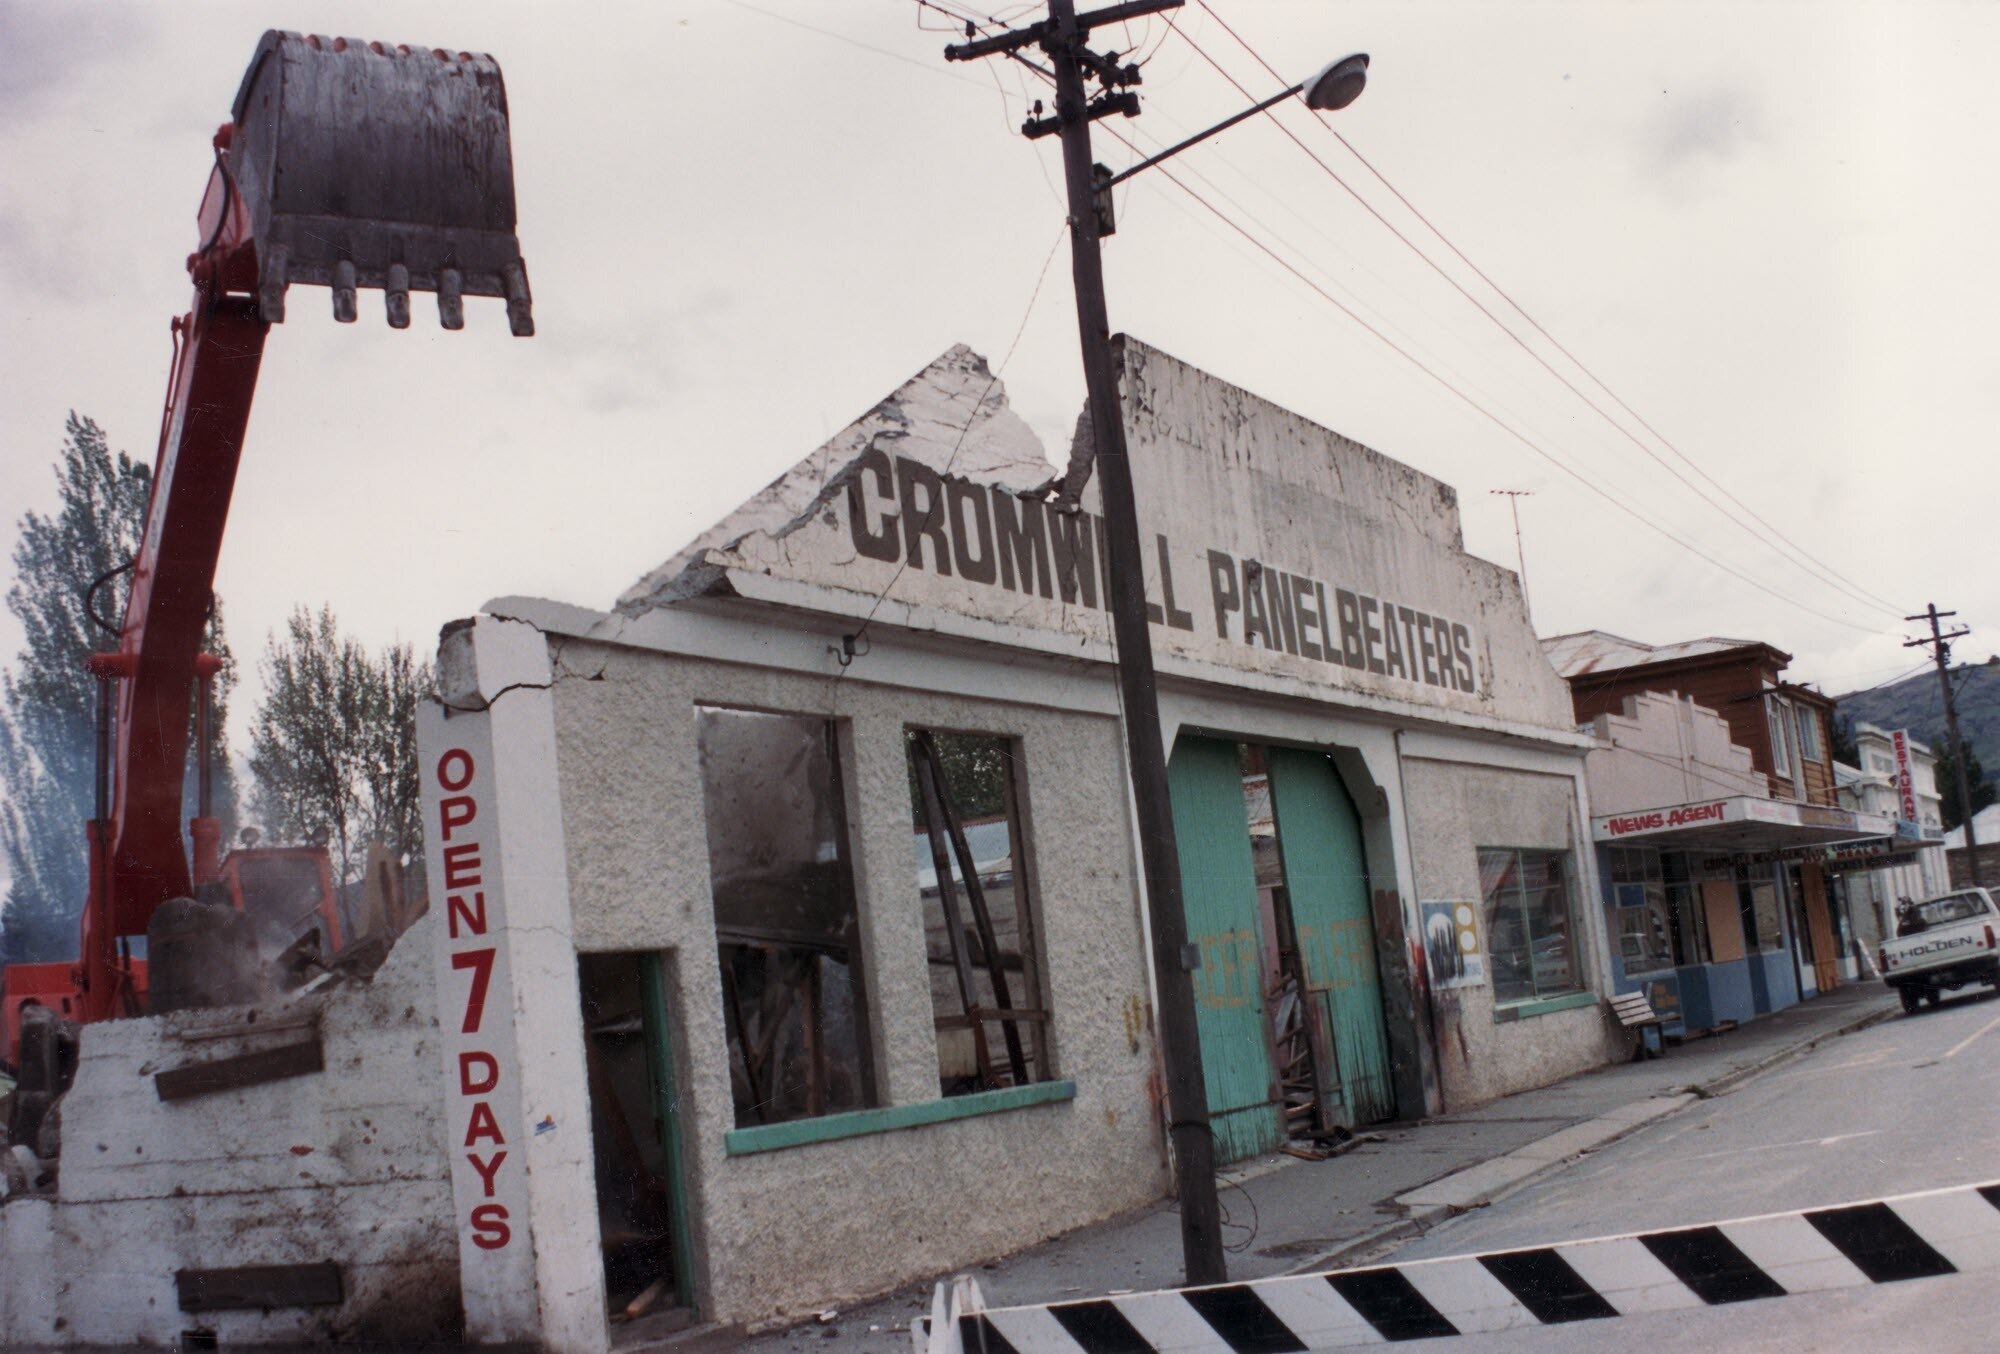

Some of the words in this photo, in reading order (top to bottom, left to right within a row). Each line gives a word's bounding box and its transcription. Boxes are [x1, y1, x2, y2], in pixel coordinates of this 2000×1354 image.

[848, 448, 1194, 632] CROMWL
[1207, 548, 1474, 693] PANELBEATERS
[1609, 814, 1664, 835] NEWS
[1667, 803, 1727, 825] AGENT
[1893, 732, 1916, 822] RESTAURANT
[436, 747, 488, 940] OPEN
[1836, 846, 1880, 859] MEALS
[451, 947, 496, 1035] 7
[1900, 935, 1973, 959] HOLDEN
[459, 1051, 512, 1250] DAYS
